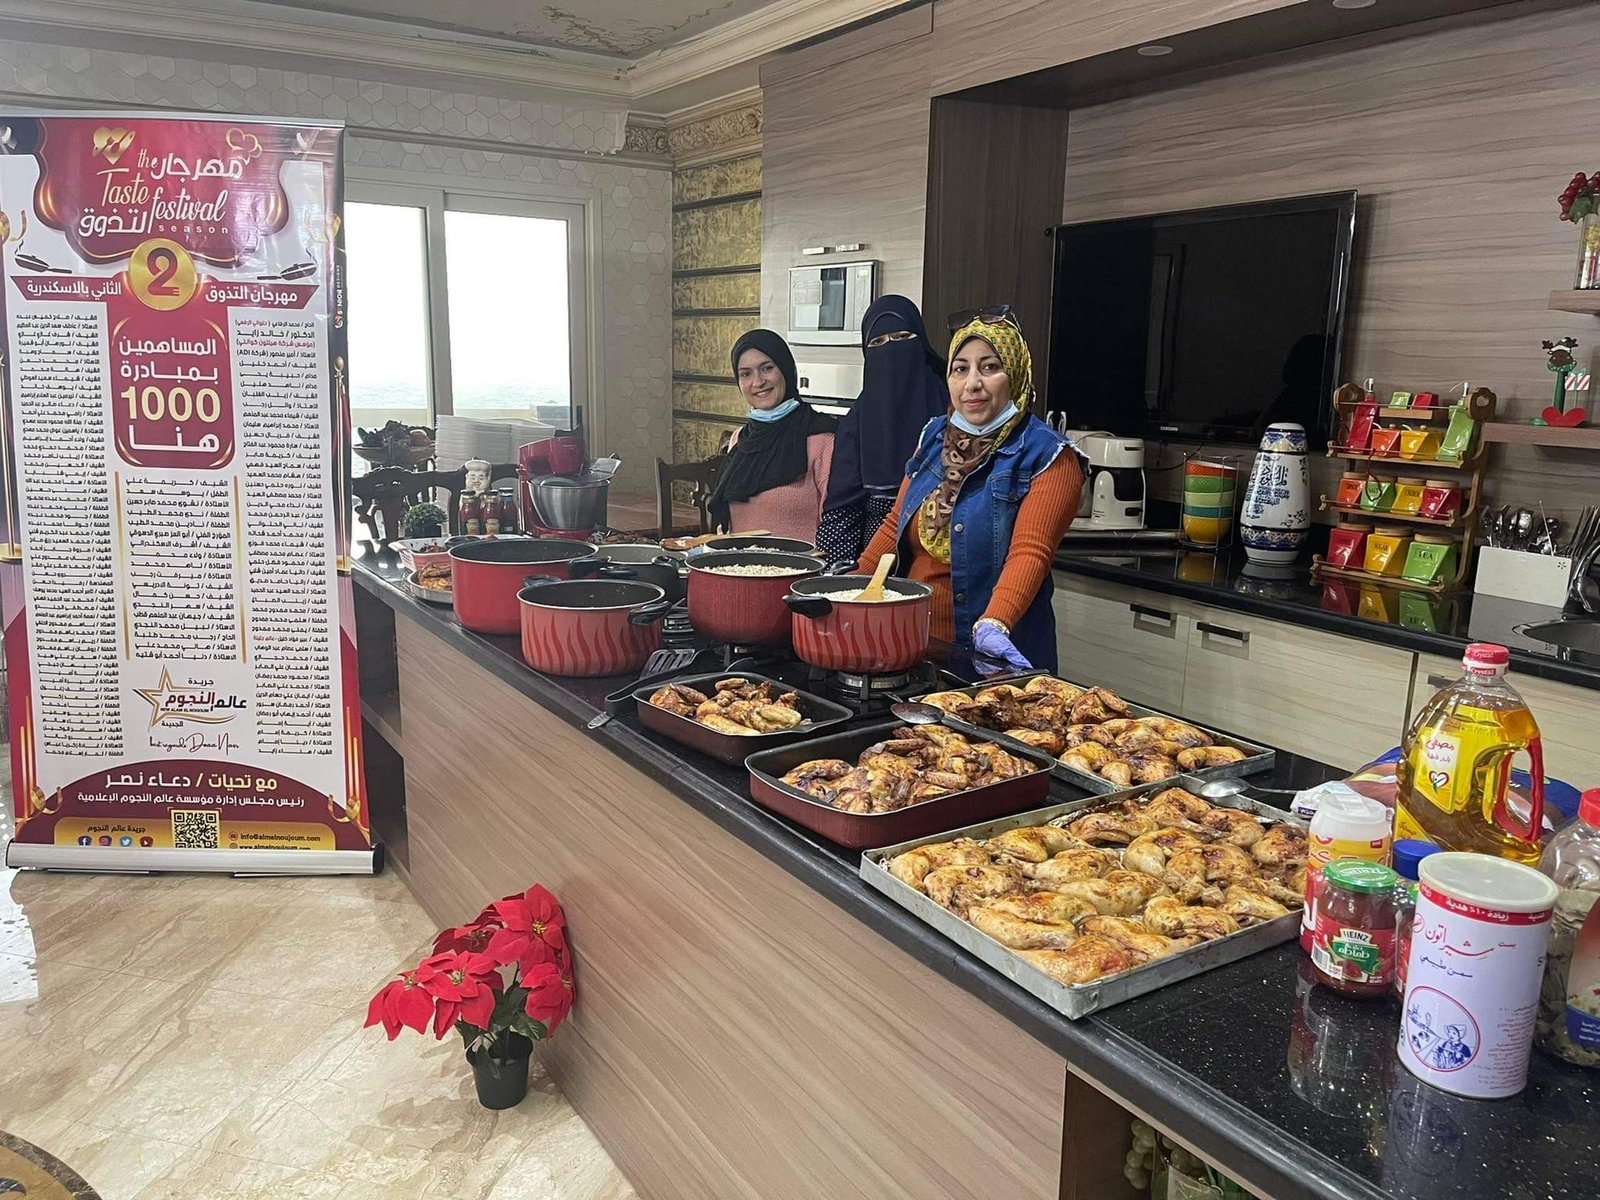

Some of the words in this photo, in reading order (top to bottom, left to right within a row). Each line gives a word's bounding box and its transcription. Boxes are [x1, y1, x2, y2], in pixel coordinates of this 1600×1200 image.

[137, 148, 159, 168] the
[96, 168, 149, 206] Taste
[148, 186, 228, 234] festival
[79, 208, 154, 237] التذوق
[158, 224, 228, 234] season
[147, 248, 180, 296] 2
[27, 280, 89, 297] بالاسكندرية
[92, 282, 122, 301] الثاني
[205, 285, 248, 302] التذوق
[251, 287, 297, 304] مهرجان
[120, 336, 216, 356] المساهمين
[121, 361, 218, 384] بمبادرة
[121, 386, 221, 422] 1000
[129, 425, 219, 452] هنا
[1418, 551, 1433, 560] TEA
[1474, 650, 1495, 658] Crystal
[188, 677, 214, 686] جريدة
[165, 691, 215, 711] النجوم
[214, 696, 247, 708] عالم
[105, 772, 144, 788] نصر
[148, 772, 191, 787] دعاء
[208, 773, 251, 791] تحيات
[256, 777, 277, 791] مع
[120, 793, 151, 803] النجوم
[154, 794, 174, 804] عالم
[176, 794, 214, 805] مؤسسة
[238, 796, 273, 806] مجلس
[128, 826, 146, 834] جريدة
[1344, 931, 1368, 942] HEINZ
